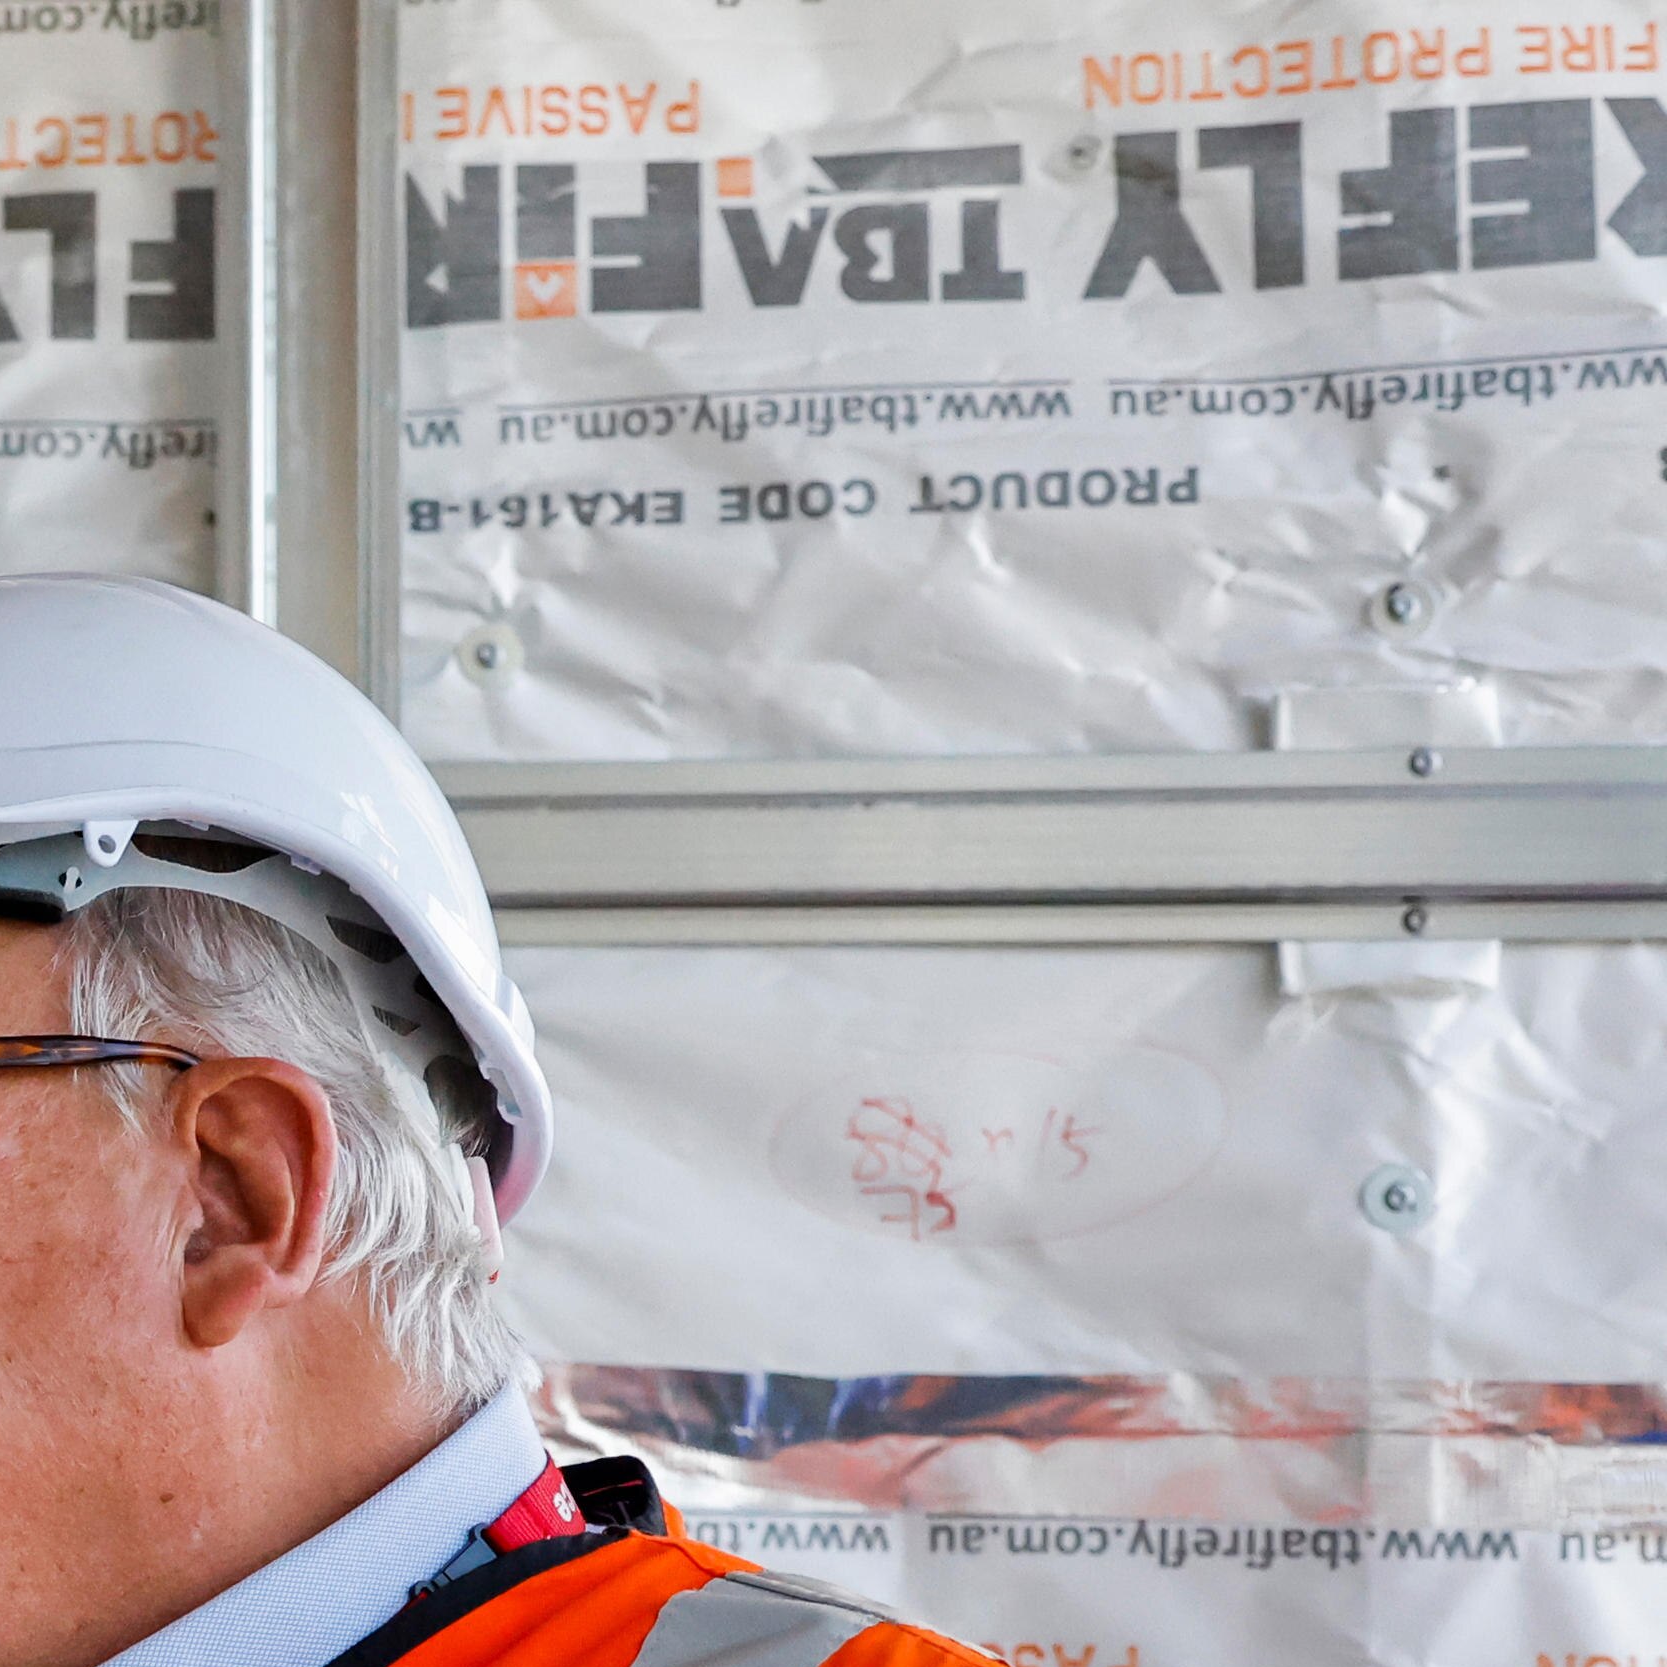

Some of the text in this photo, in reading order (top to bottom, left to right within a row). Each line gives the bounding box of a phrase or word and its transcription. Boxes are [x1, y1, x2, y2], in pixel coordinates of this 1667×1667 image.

[1083, 20, 1659, 110] FIRE PROTECTION
[434, 79, 701, 140] PASSIVE
[500, 386, 1071, 444] www.tbafirefly.com.au
[719, 480, 877, 523] CODE
[910, 466, 1200, 514] PRODUCT
[930, 1519, 1519, 1570] www.tbafirefly.com.au
